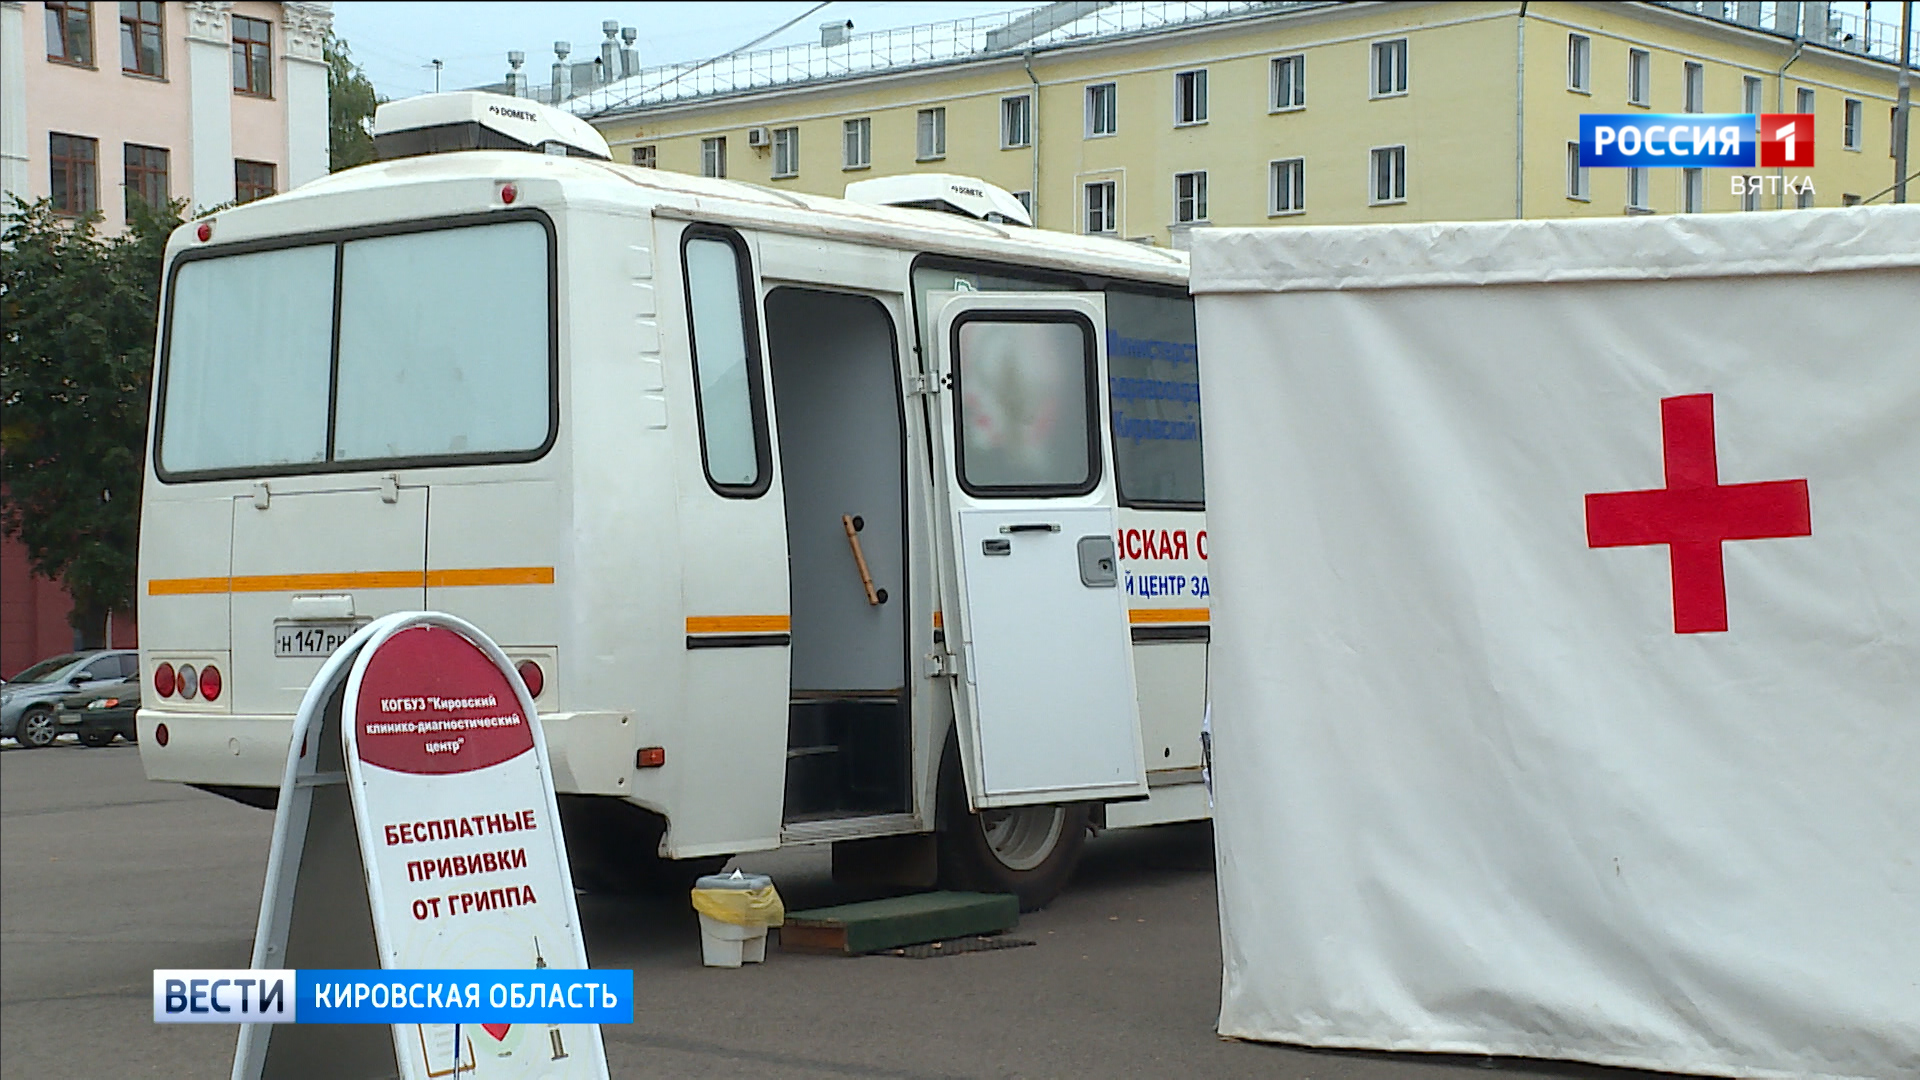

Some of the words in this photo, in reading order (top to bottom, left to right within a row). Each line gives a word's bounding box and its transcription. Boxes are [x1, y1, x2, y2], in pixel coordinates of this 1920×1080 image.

[500, 107, 538, 122] DOMETIC
[1138, 575, 1186, 600] ЦЕНТР
[381, 697, 427, 712] КОГБУЗ
[427, 694, 497, 712] "Кировский
[366, 713, 521, 735] клинико-диагностический
[425, 737, 465, 754] центр"
[384, 809, 537, 846] БЕСПЛАТНЫЕ
[407, 848, 528, 883] ПРИВИВКИ
[412, 897, 441, 921] ОТ
[447, 884, 537, 916] ГРИППА
